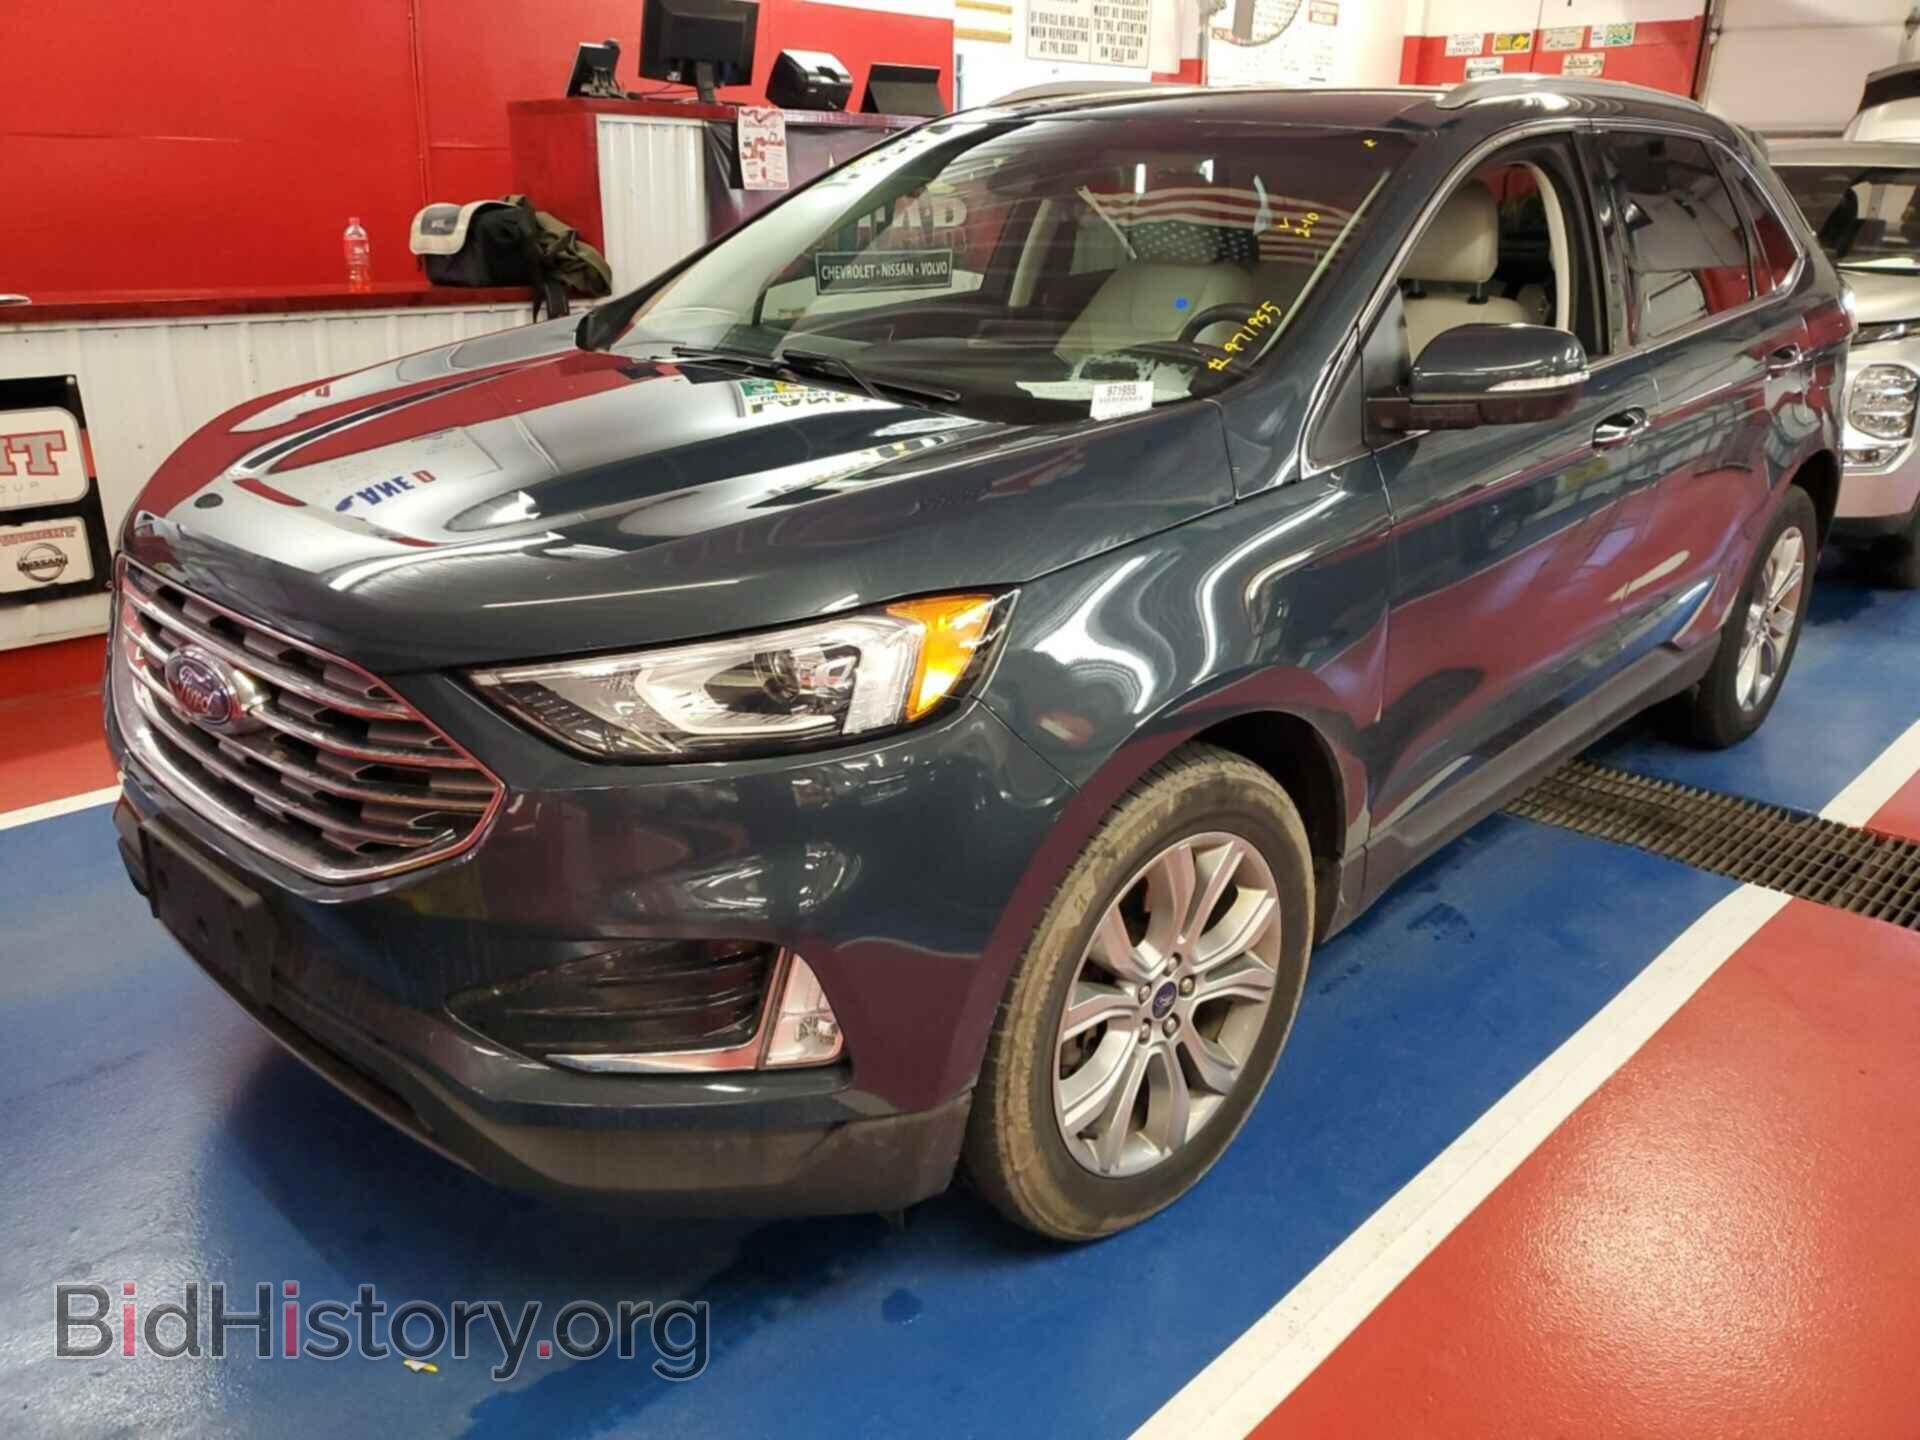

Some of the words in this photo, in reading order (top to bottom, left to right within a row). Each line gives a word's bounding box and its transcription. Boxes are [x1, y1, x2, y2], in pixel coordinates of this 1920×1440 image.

[1103, 19, 1114, 32] THE
[1117, 21, 1147, 35] ATTENTION
[821, 264, 875, 280] CHEVROLET
[881, 262, 914, 278] NISSAN
[921, 261, 948, 276] VOLVO
